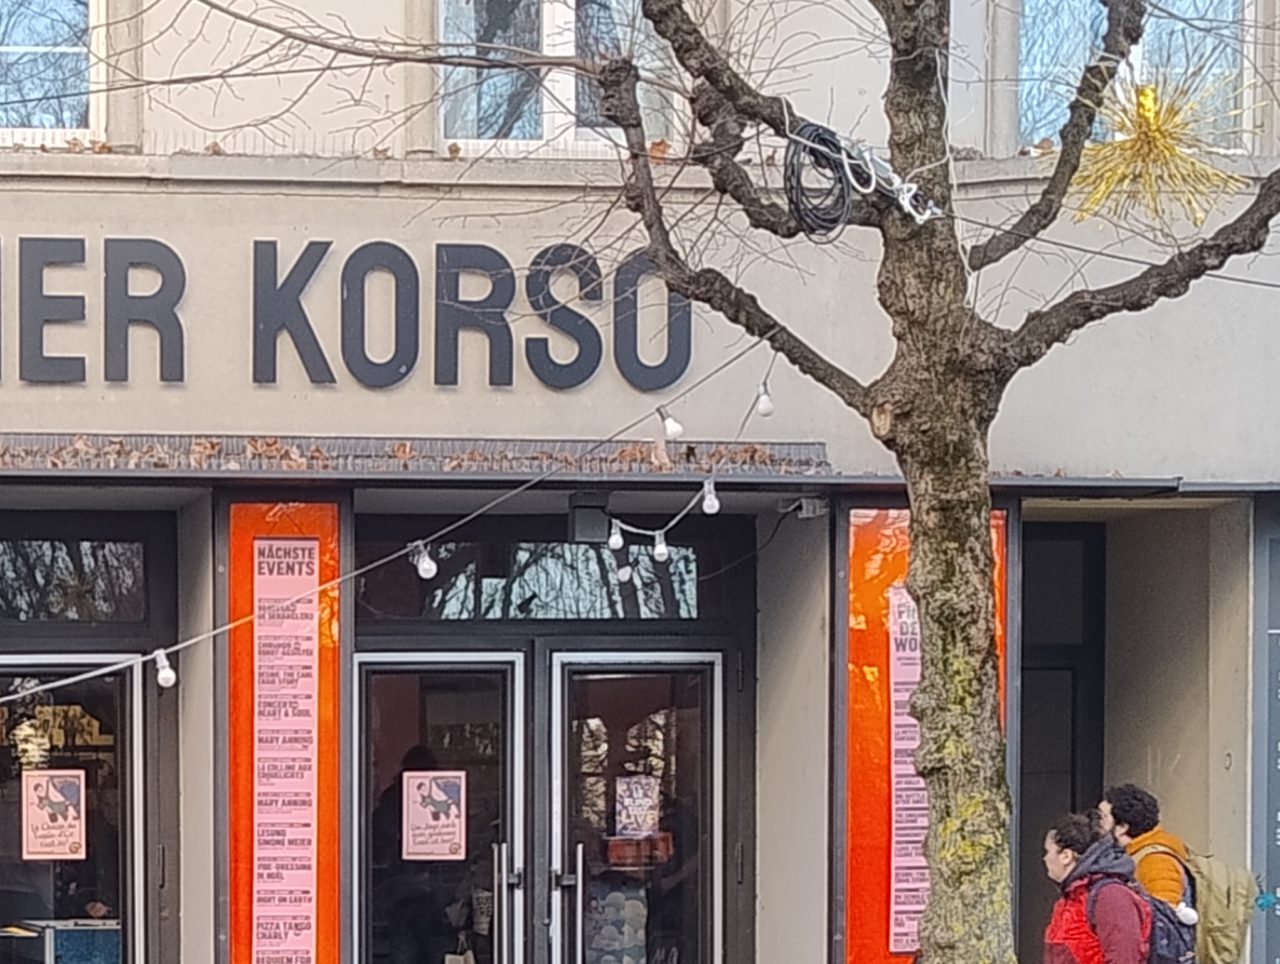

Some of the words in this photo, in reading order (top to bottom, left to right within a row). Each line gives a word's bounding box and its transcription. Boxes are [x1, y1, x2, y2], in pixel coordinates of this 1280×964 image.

[252, 239, 694, 393] KORSO
[257, 546, 315, 560] NÄCHSTE
[257, 561, 315, 576] EVENTS
[258, 709, 281, 718] HEART
[292, 709, 311, 718] SOUL
[258, 736, 280, 745] MARY
[257, 799, 279, 807] MARY
[257, 829, 287, 837] LESUNG
[257, 838, 285, 847] SIMONE
[288, 838, 312, 847] MEIER
[256, 922, 280, 931] PIZZA
